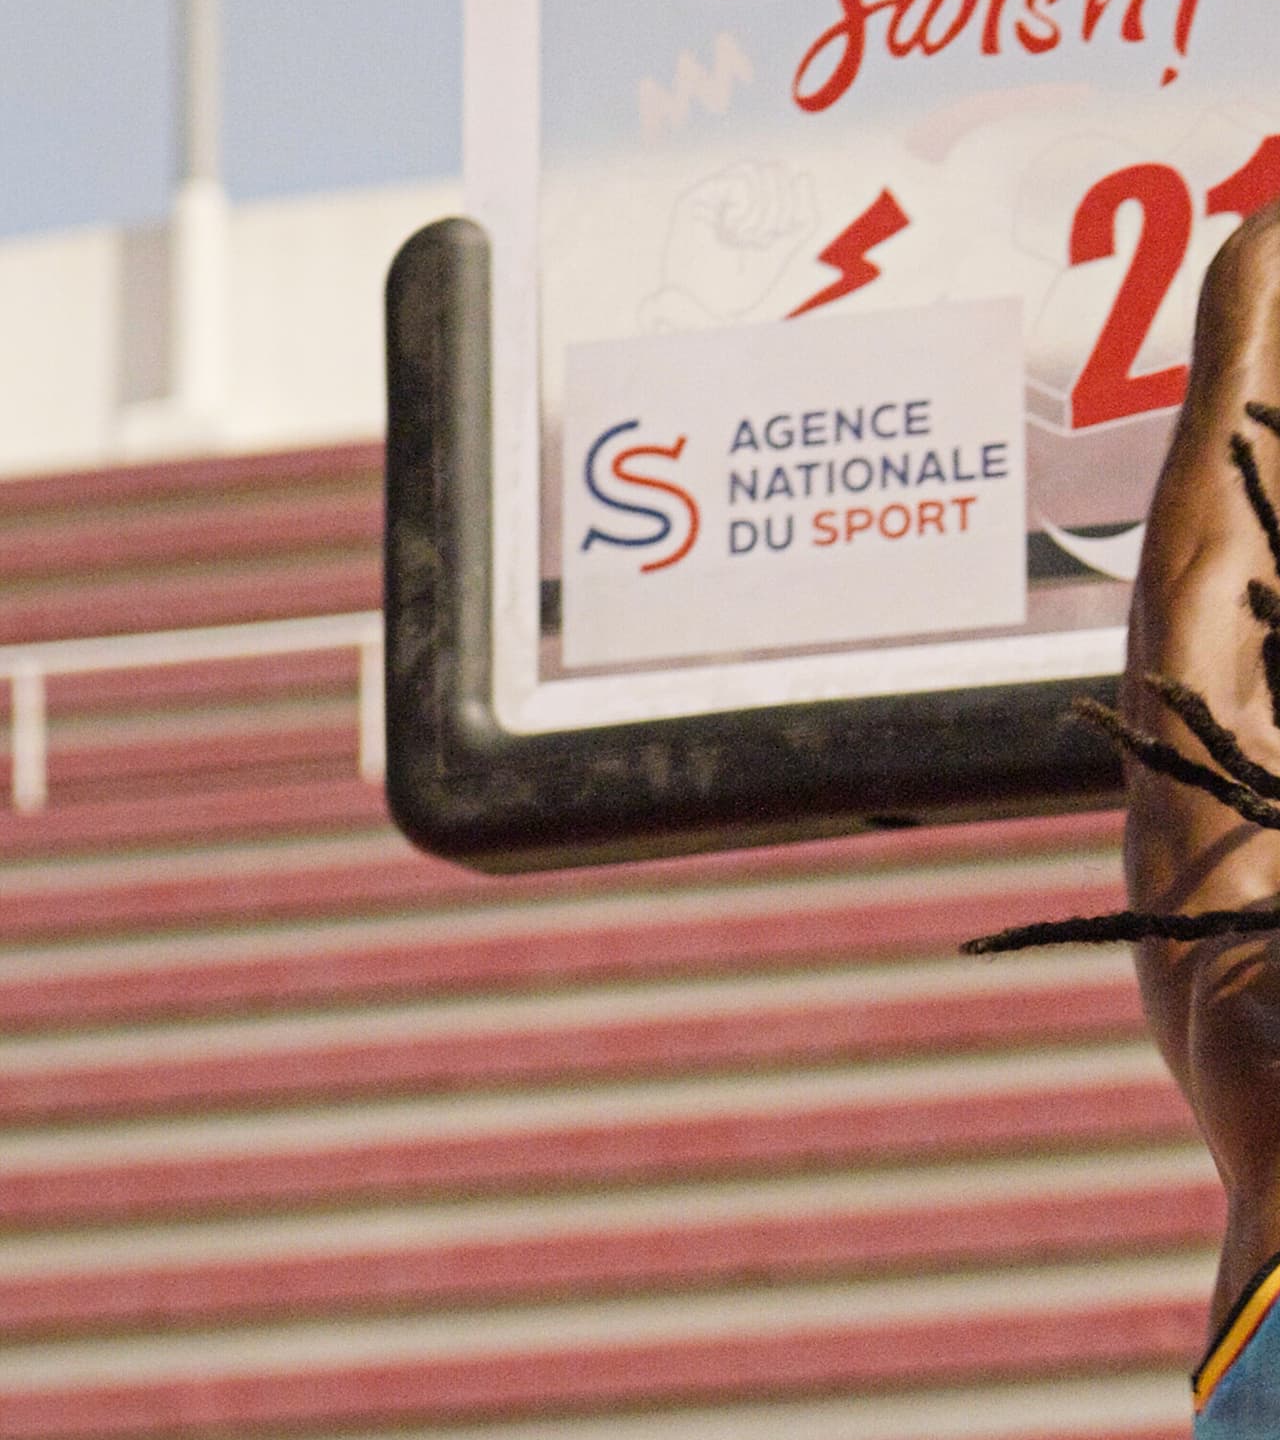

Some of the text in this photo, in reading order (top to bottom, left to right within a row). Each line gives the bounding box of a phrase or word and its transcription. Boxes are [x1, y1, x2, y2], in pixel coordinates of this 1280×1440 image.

[729, 398, 932, 456] AGENCE
[728, 442, 1010, 506] NATIONALE
[728, 495, 978, 558] DU SPORT
